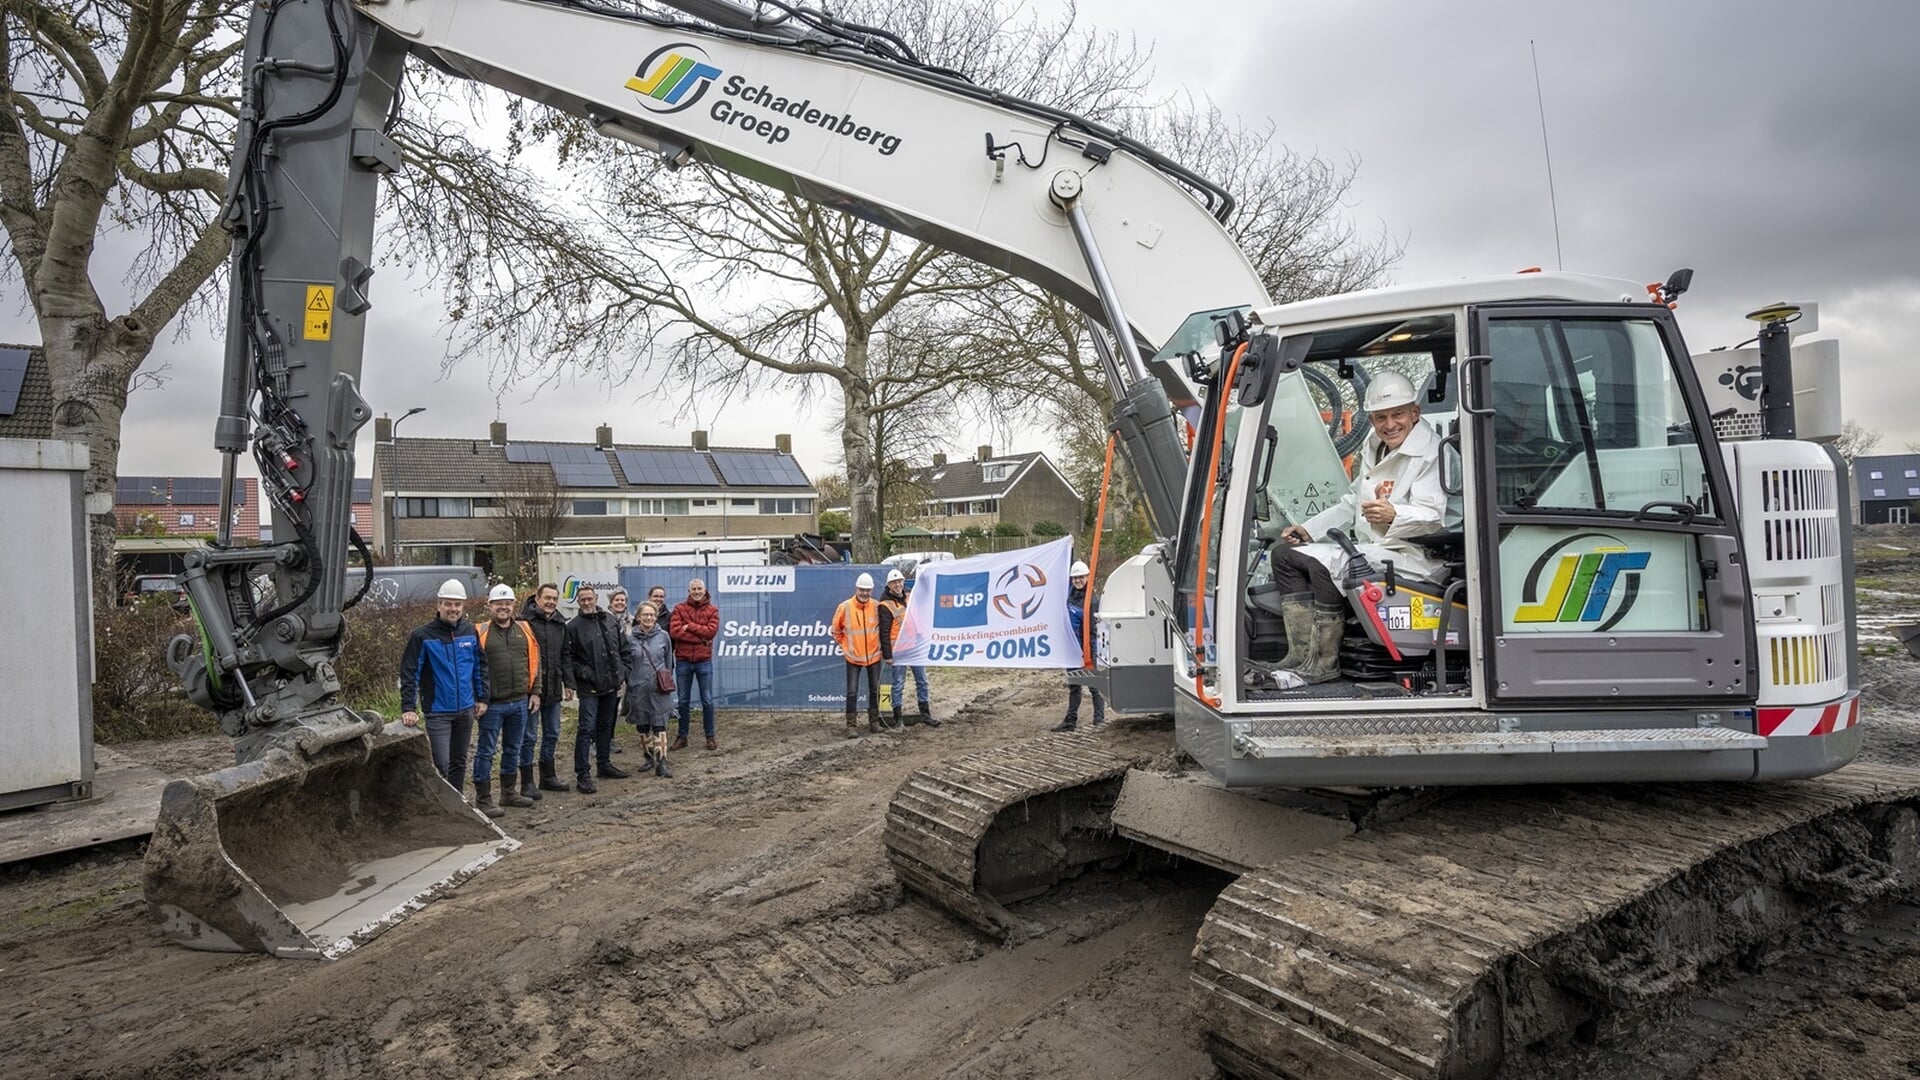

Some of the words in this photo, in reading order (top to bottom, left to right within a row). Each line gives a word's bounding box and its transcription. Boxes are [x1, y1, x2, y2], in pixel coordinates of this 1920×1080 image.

[710, 100, 790, 144] Groep
[723, 75, 902, 156] Schadenberg
[727, 575, 753, 585] WIJ
[755, 575, 787, 585] ZIJN
[953, 592, 984, 608] USP
[1390, 616, 1404, 628] 101
[931, 622, 1049, 641] Ontwikkelingscombinatie
[717, 641, 846, 656] Infratechnie
